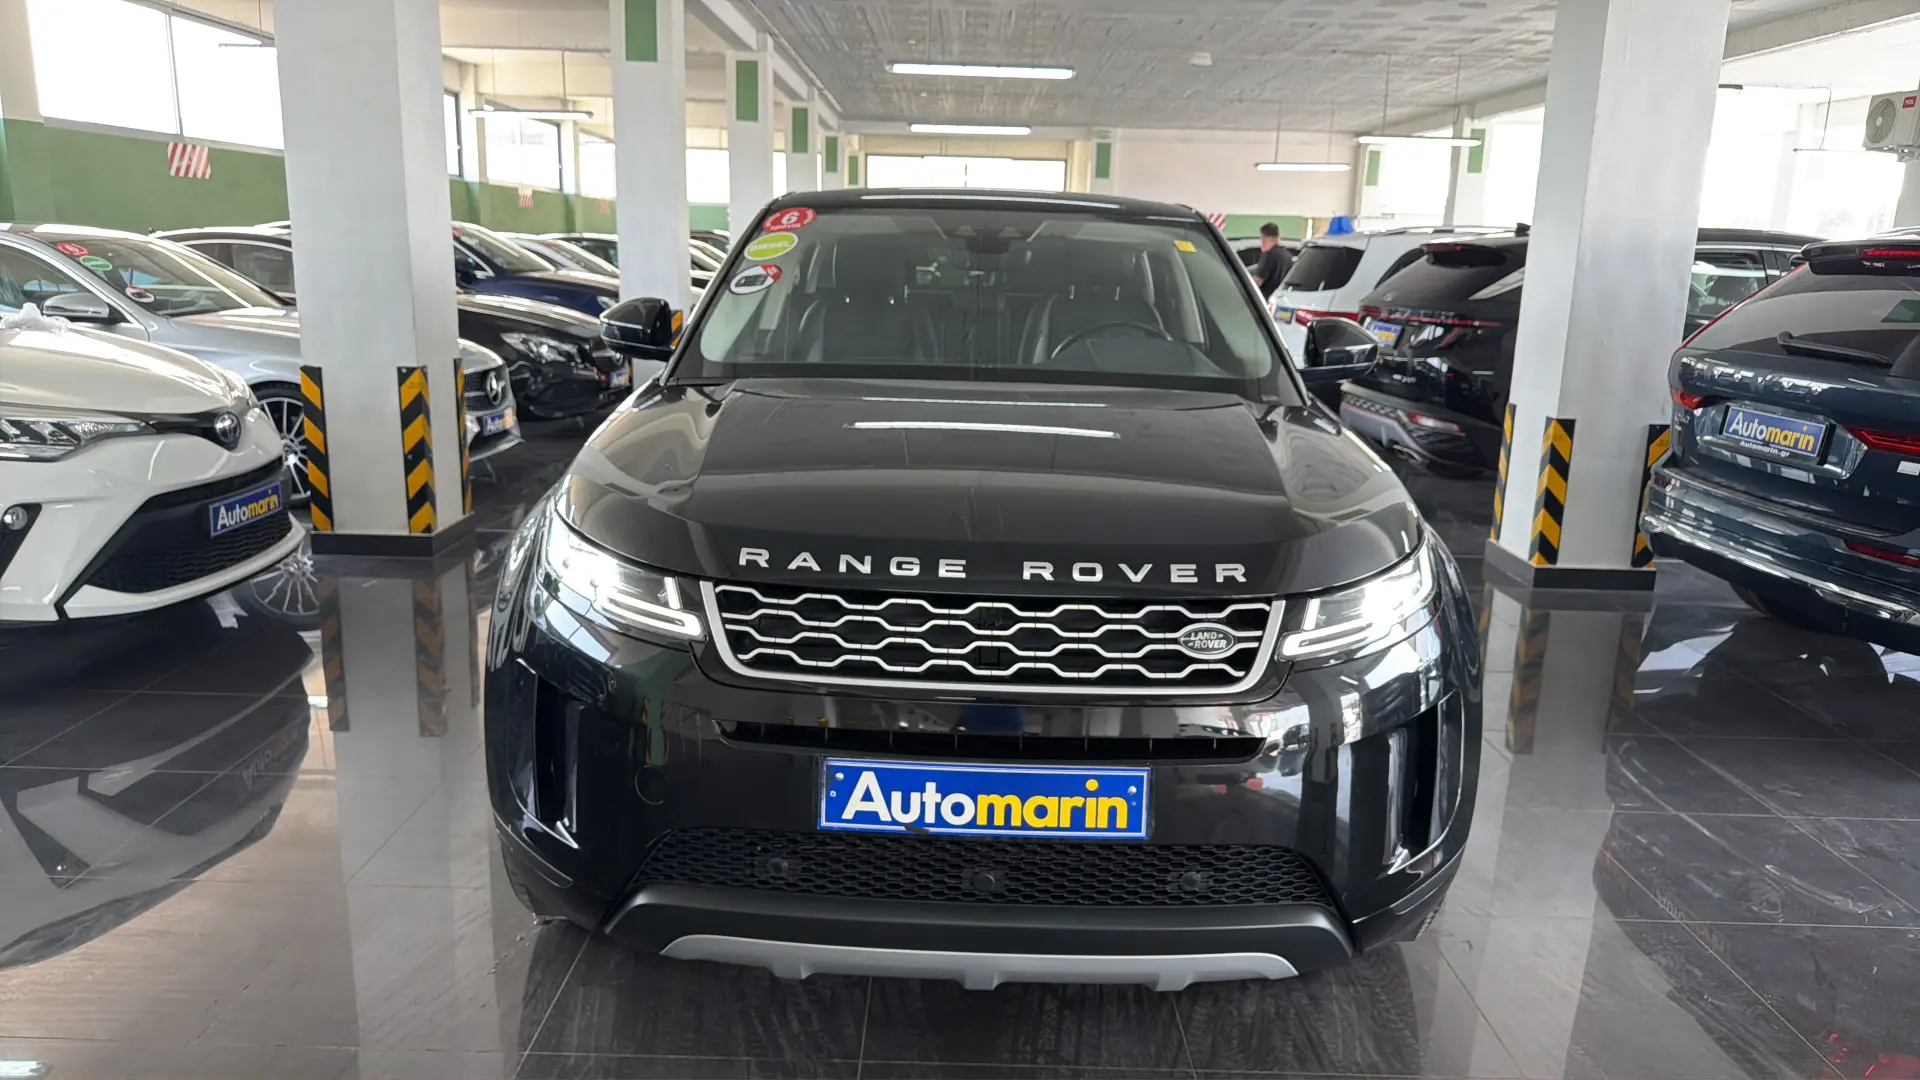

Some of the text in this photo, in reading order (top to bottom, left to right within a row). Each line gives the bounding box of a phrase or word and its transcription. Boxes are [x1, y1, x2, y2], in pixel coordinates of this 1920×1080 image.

[781, 211, 799, 224] 6
[1728, 411, 1815, 452] Automarin
[1739, 440, 1790, 457] Automarin.gr
[217, 488, 279, 530] Automarin
[738, 546, 1247, 583] RANGE ROVER
[1190, 632, 1217, 640] LAND
[1193, 639, 1226, 648] ROVER
[841, 770, 1128, 829] Automarin
